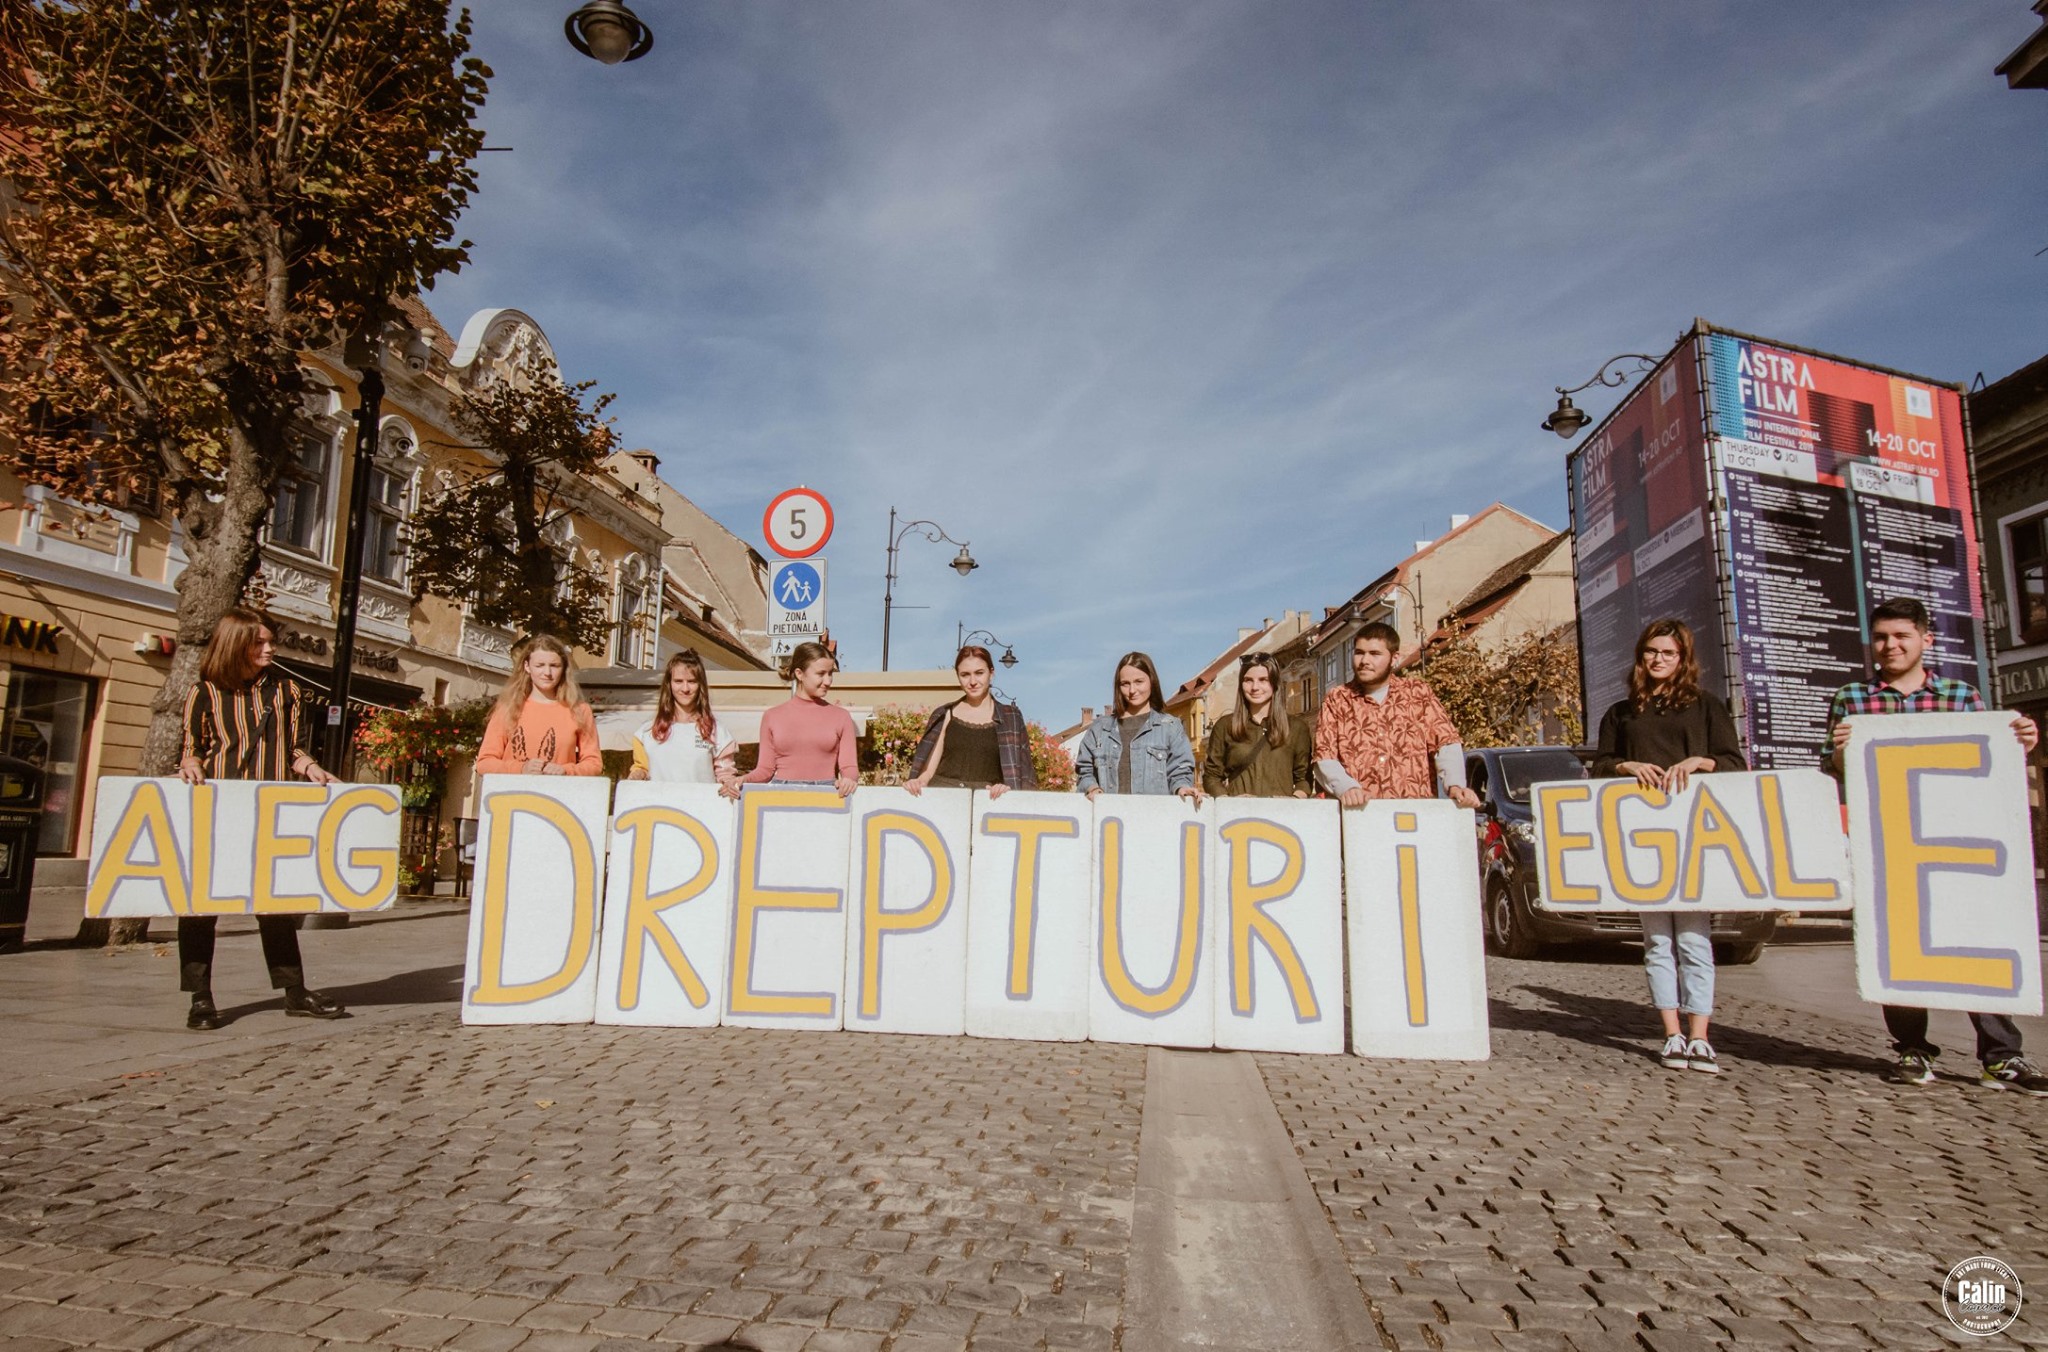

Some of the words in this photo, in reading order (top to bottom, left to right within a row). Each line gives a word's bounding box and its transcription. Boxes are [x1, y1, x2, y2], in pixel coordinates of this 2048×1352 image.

[1737, 347, 1816, 390] ASTRA
[1737, 377, 1799, 416] FILM
[1743, 430, 1763, 442] FILM
[1764, 434, 1797, 449] FESTIVAL
[1764, 421, 1822, 441] INTERNATIONAL
[1866, 428, 1902, 453] 14-20
[1908, 438, 1937, 459] OCT
[1582, 431, 1614, 479] ASTRA
[1726, 441, 1770, 457] THURSDAY
[1738, 455, 1756, 467] OCT
[1581, 463, 1607, 504] FILM
[790, 509, 807, 540] 5
[86, 780, 401, 917] ALEG
